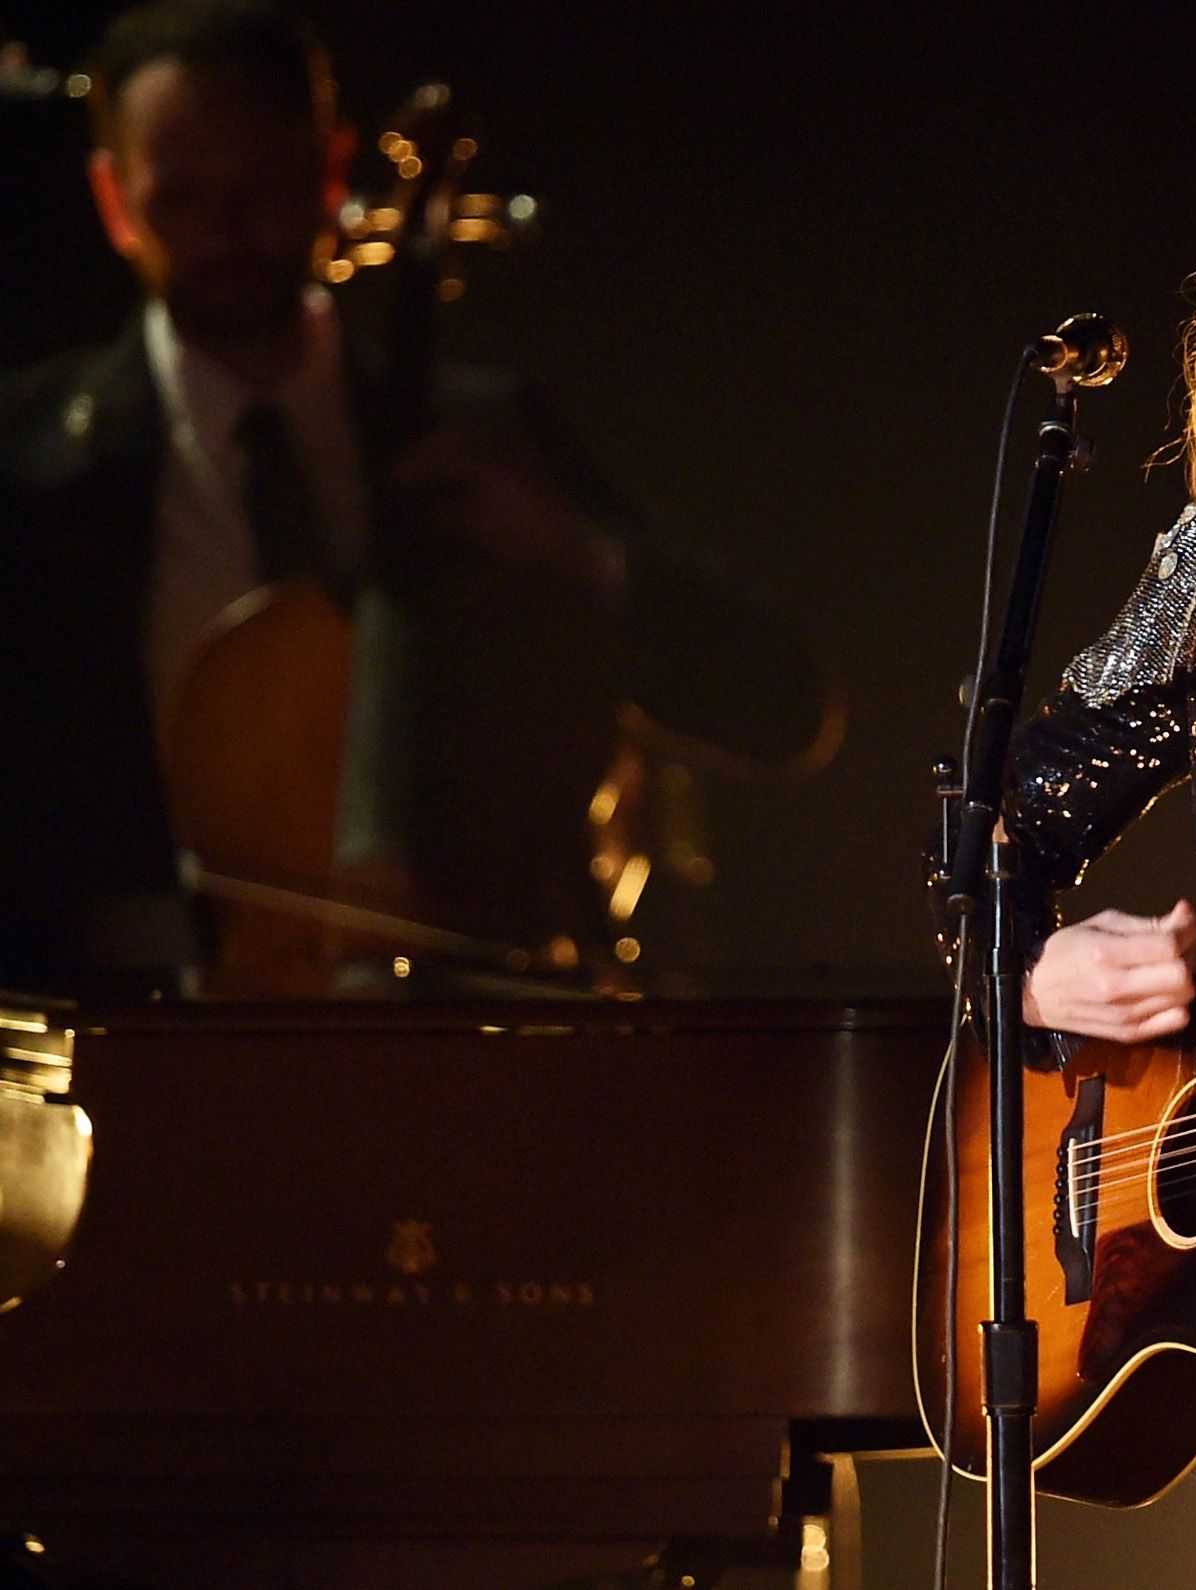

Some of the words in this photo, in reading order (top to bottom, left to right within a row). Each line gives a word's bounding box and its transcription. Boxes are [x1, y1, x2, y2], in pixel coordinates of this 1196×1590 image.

[229, 1281, 430, 1305] STEINWAY
[453, 1282, 471, 1304] &
[496, 1281, 595, 1305] SONS
